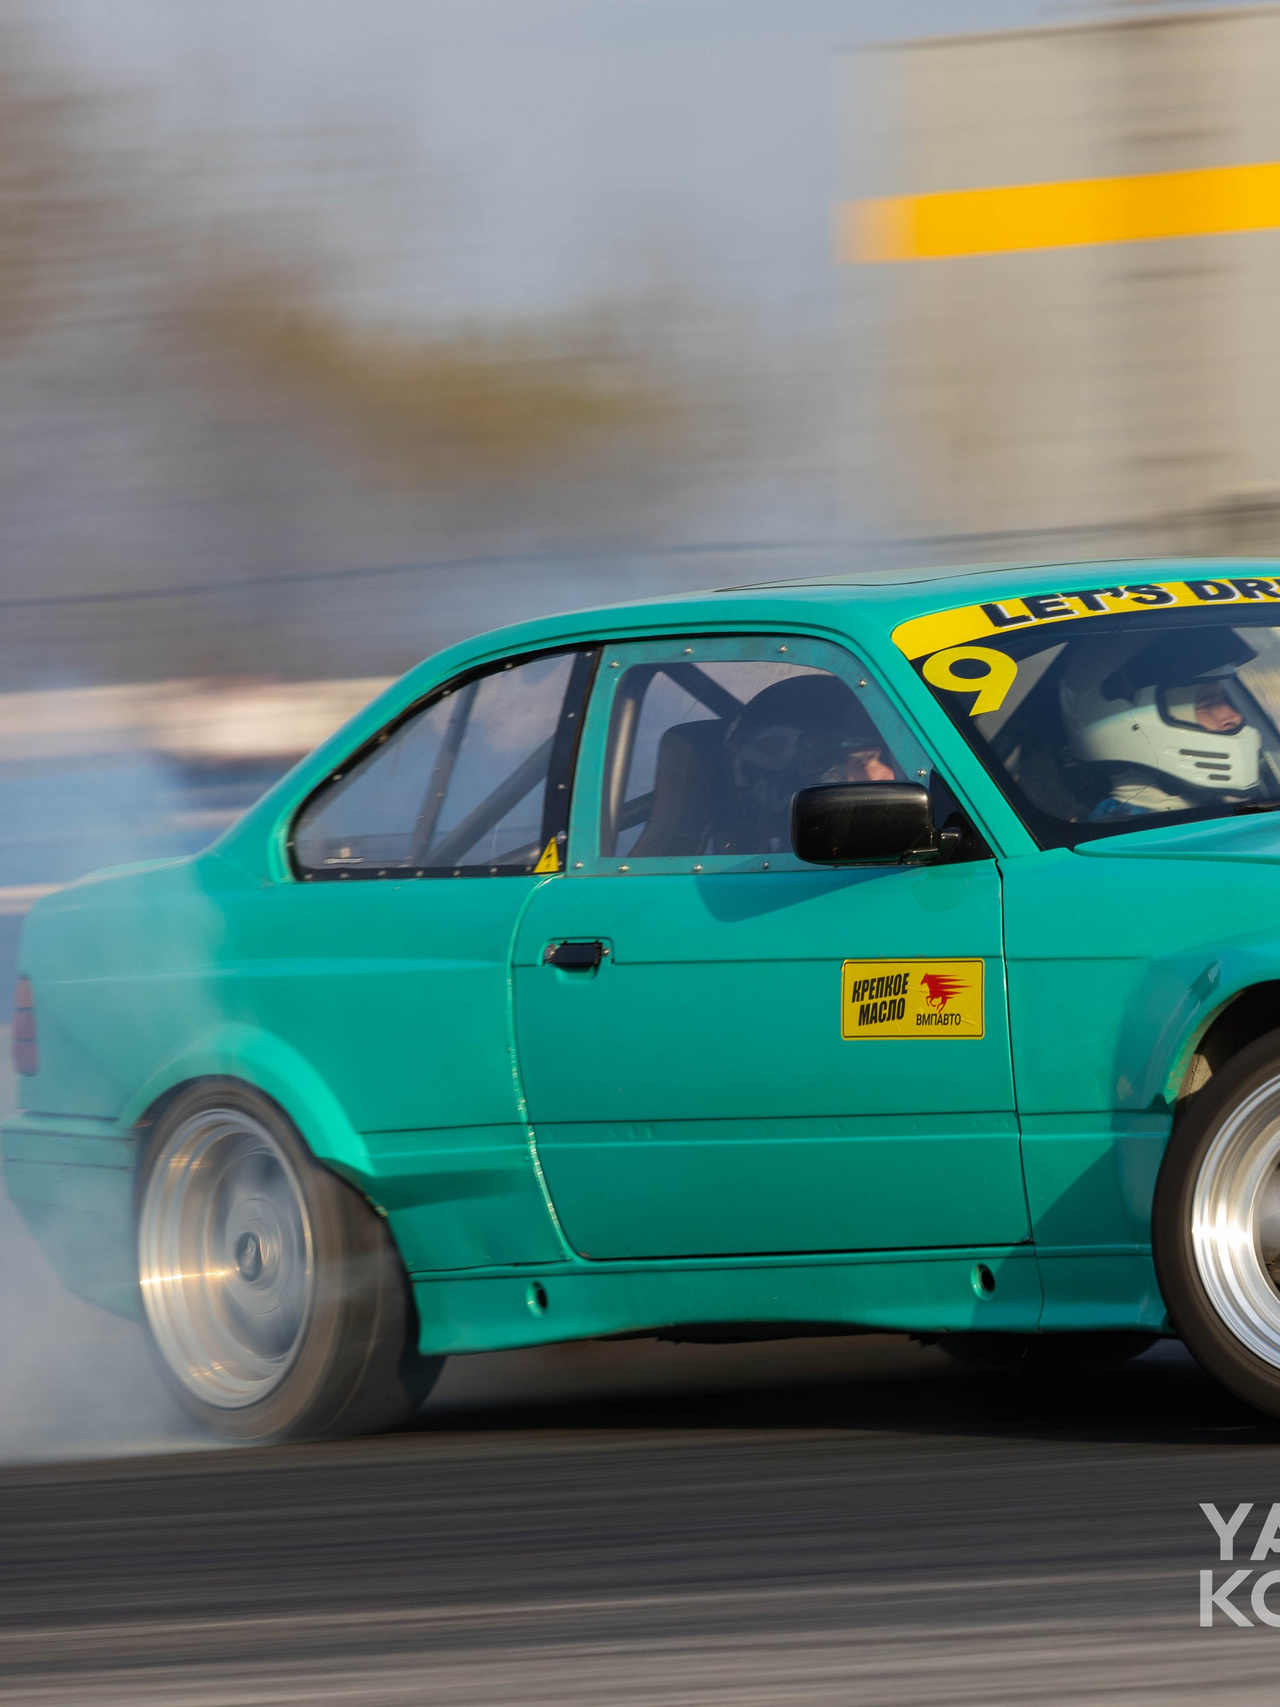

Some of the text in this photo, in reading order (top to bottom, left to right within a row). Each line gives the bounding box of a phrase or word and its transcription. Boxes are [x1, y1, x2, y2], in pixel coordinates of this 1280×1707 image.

[979, 584, 1178, 629] LET'S
[922, 645, 1018, 717] 9
[852, 973, 910, 1003] КРЕПКОЕ
[858, 997, 906, 1026] МАСЛО
[916, 1013, 962, 1026] ВМПАВТО
